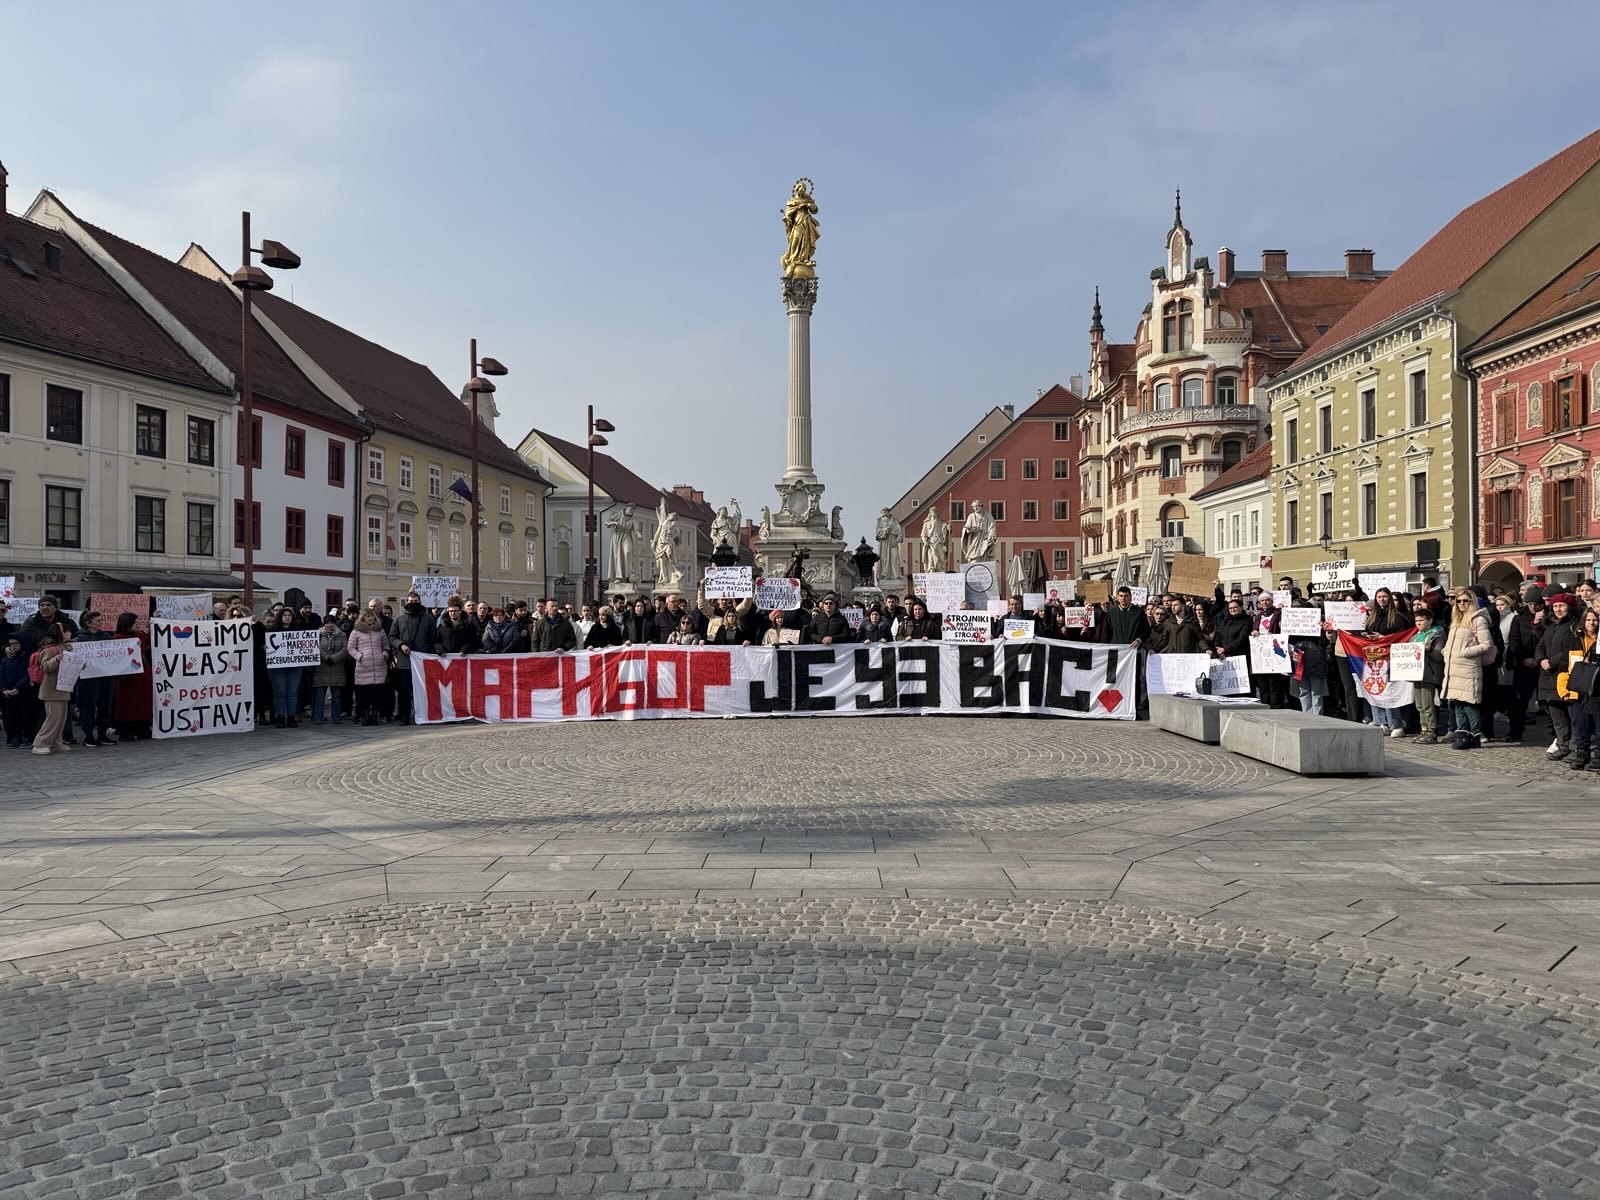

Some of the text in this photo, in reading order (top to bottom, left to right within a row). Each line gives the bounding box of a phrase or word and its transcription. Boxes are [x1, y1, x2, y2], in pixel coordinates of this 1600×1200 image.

[34, 571, 67, 584] SVEČAR
[946, 614, 989, 623] STROJNIKI
[282, 632, 300, 640] HALO
[162, 649, 249, 677] VLAST
[156, 679, 174, 694] DA
[422, 650, 732, 721] МАРИБОР
[749, 649, 836, 713] ЈЕ
[854, 646, 941, 710] УЗ
[178, 684, 242, 701] POŠTUJE
[158, 701, 253, 734] USTAV!
